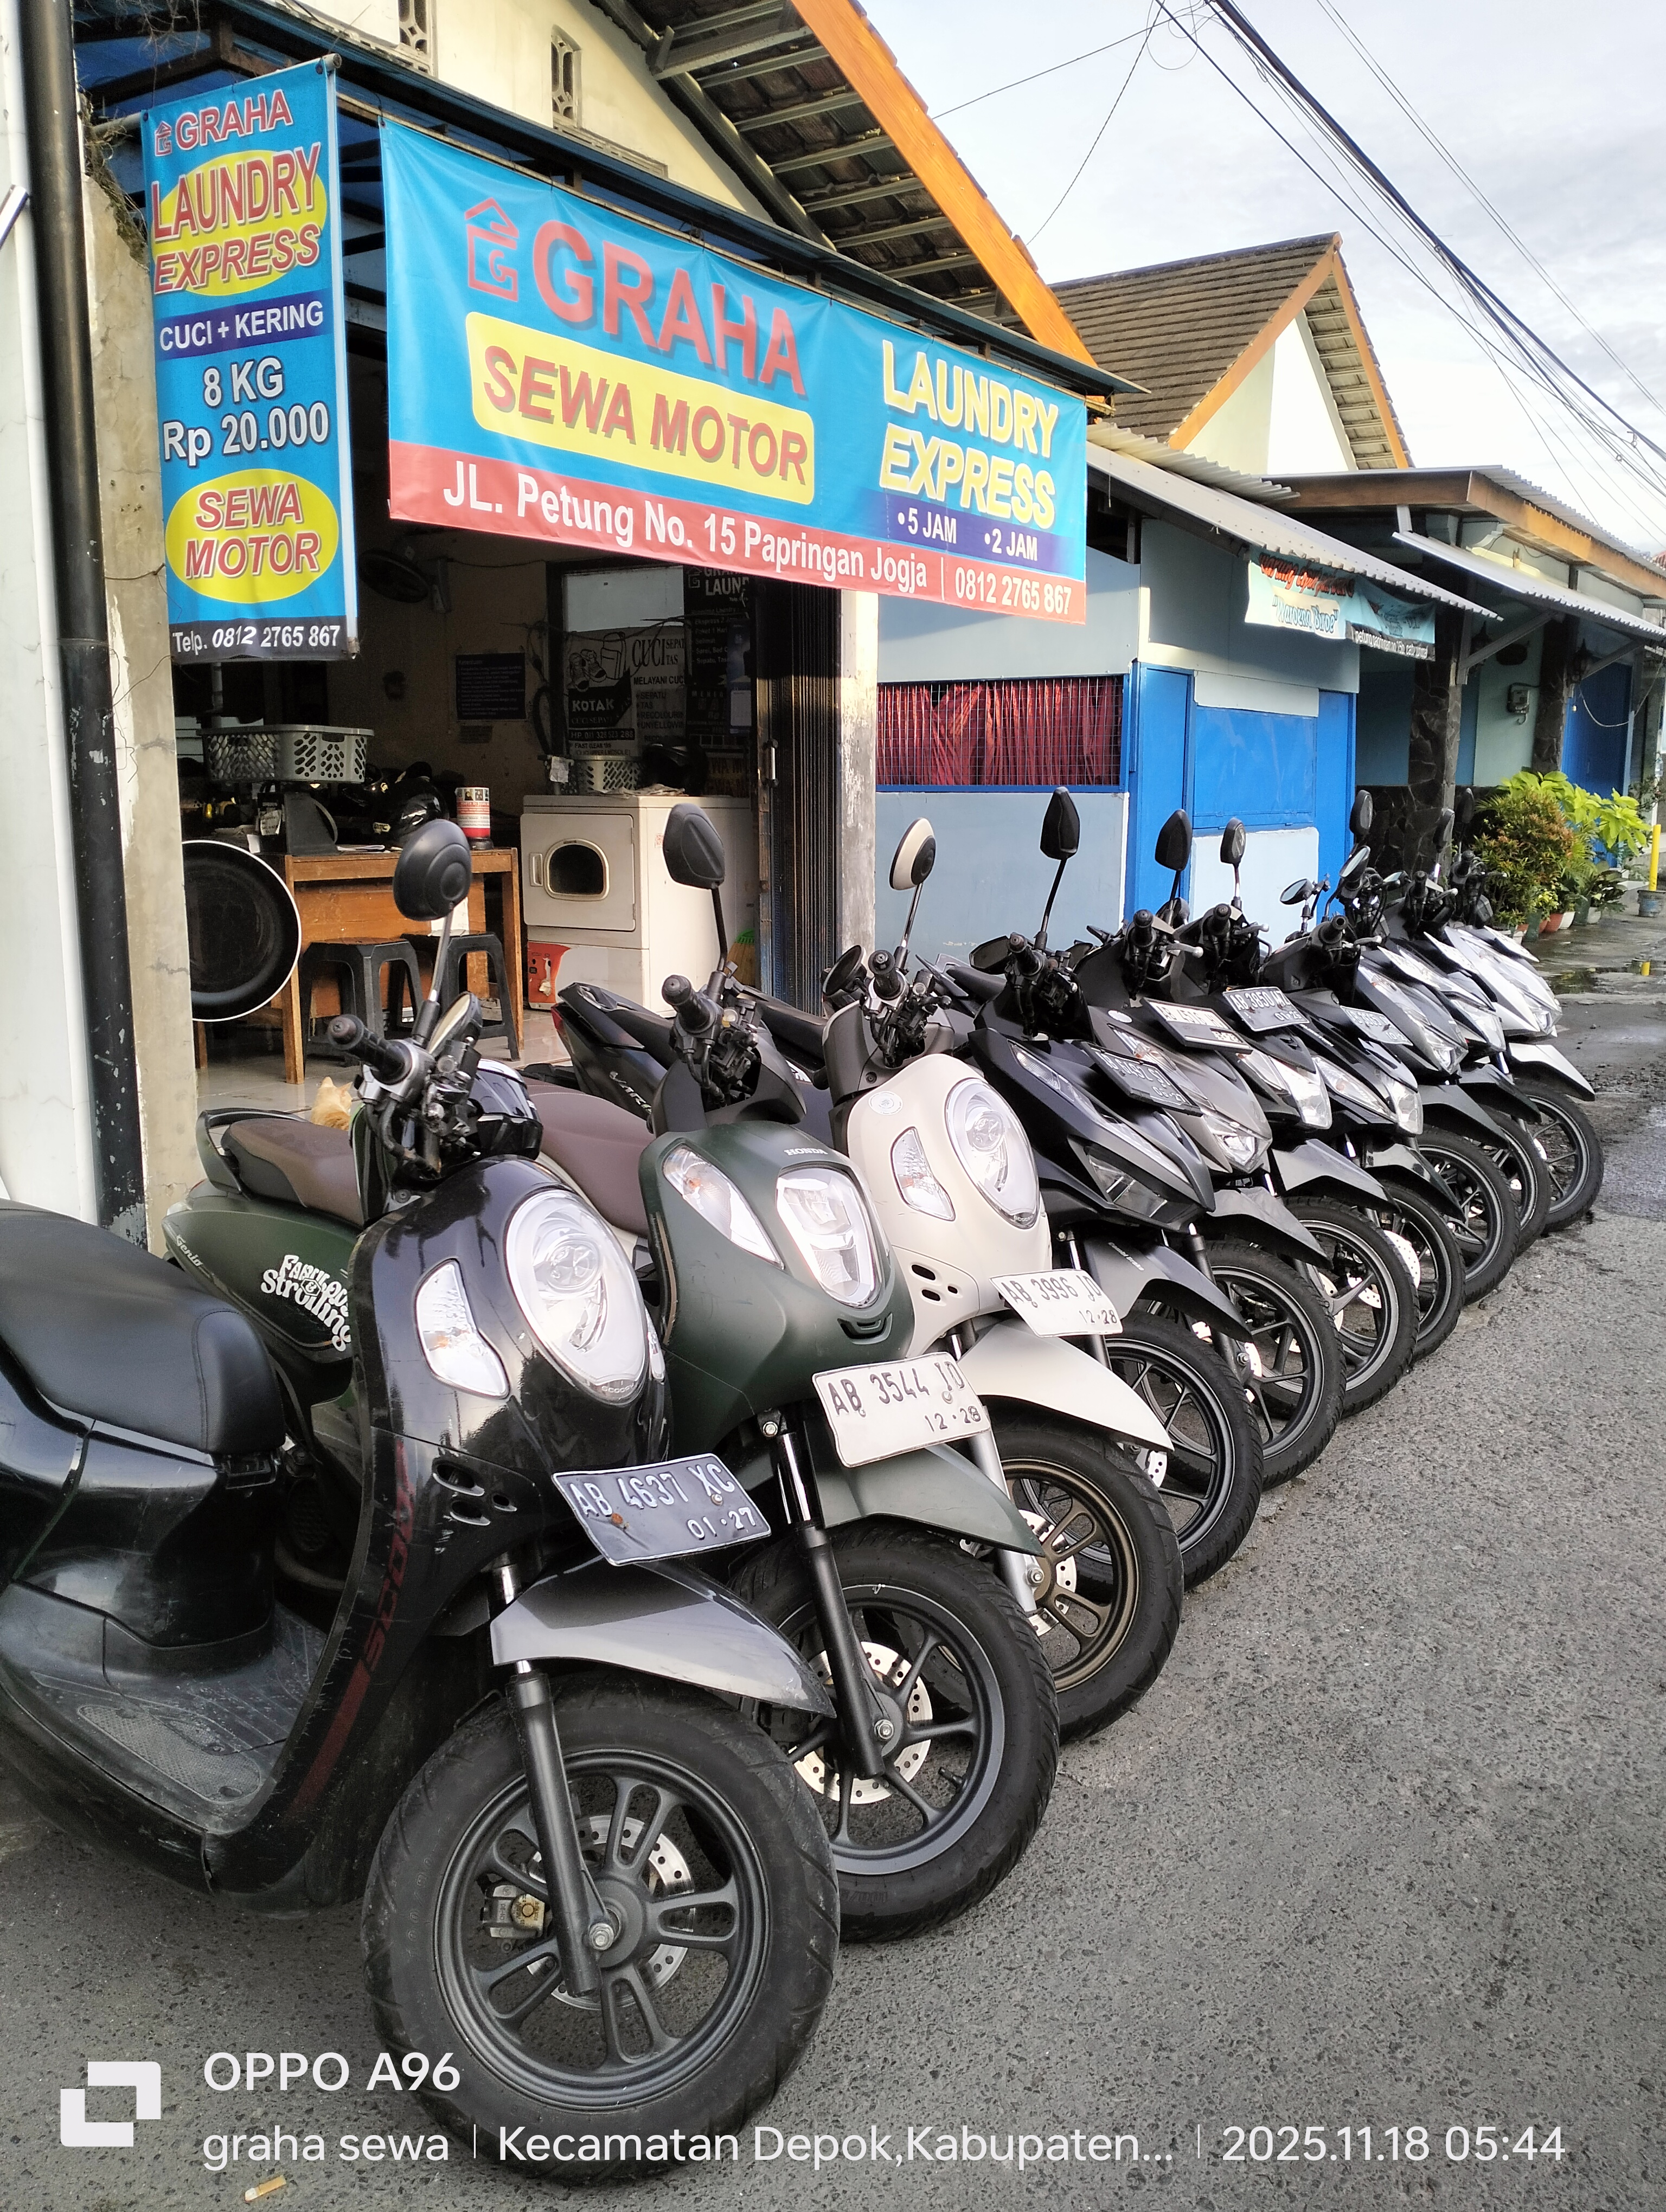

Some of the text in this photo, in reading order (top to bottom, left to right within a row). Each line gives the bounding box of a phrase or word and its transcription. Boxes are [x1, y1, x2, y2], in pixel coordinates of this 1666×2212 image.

[176, 89, 293, 150] GRAHA
[151, 142, 322, 242] LAUNDRY
[154, 224, 321, 295] EXPRESS
[160, 321, 212, 351] CUCI
[235, 301, 324, 339] KERING
[532, 220, 808, 397] GRAHA
[203, 356, 284, 408] 8 KG
[882, 339, 1059, 459] LAUNDRY
[163, 401, 329, 466] Rp 20.000
[483, 345, 808, 486] SEWA MOTOR
[879, 422, 1056, 530] EXPRESS
[196, 483, 303, 530] SEWA
[444, 461, 928, 594] JL. Petung No. 15 Papringan Jogja
[922, 512, 957, 544] JAM
[185, 532, 322, 580] MOTOR
[1006, 531, 1038, 561] JAM
[954, 567, 1072, 615] 0812 2765 867
[172, 625, 341, 655] Telp. 0812 2765 867
[632, 638, 665, 667] CUCI
[667, 655, 678, 665] TAS
[572, 698, 615, 712] KOTAK
[633, 677, 667, 685] MELAYANI
[1230, 994, 1250, 1011] AB
[1245, 991, 1276, 1008] 3850
[1095, 1051, 1119, 1070] AB
[784, 1148, 829, 1156] HONDA
[176, 1234, 203, 1266] Genio
[1001, 1280, 1034, 1304] AB
[1030, 1276, 1079, 1301] 3996
[828, 1379, 863, 1416] AB
[870, 1368, 930, 1405] 3544
[569, 1463, 735, 1517] AB 4637 XC
